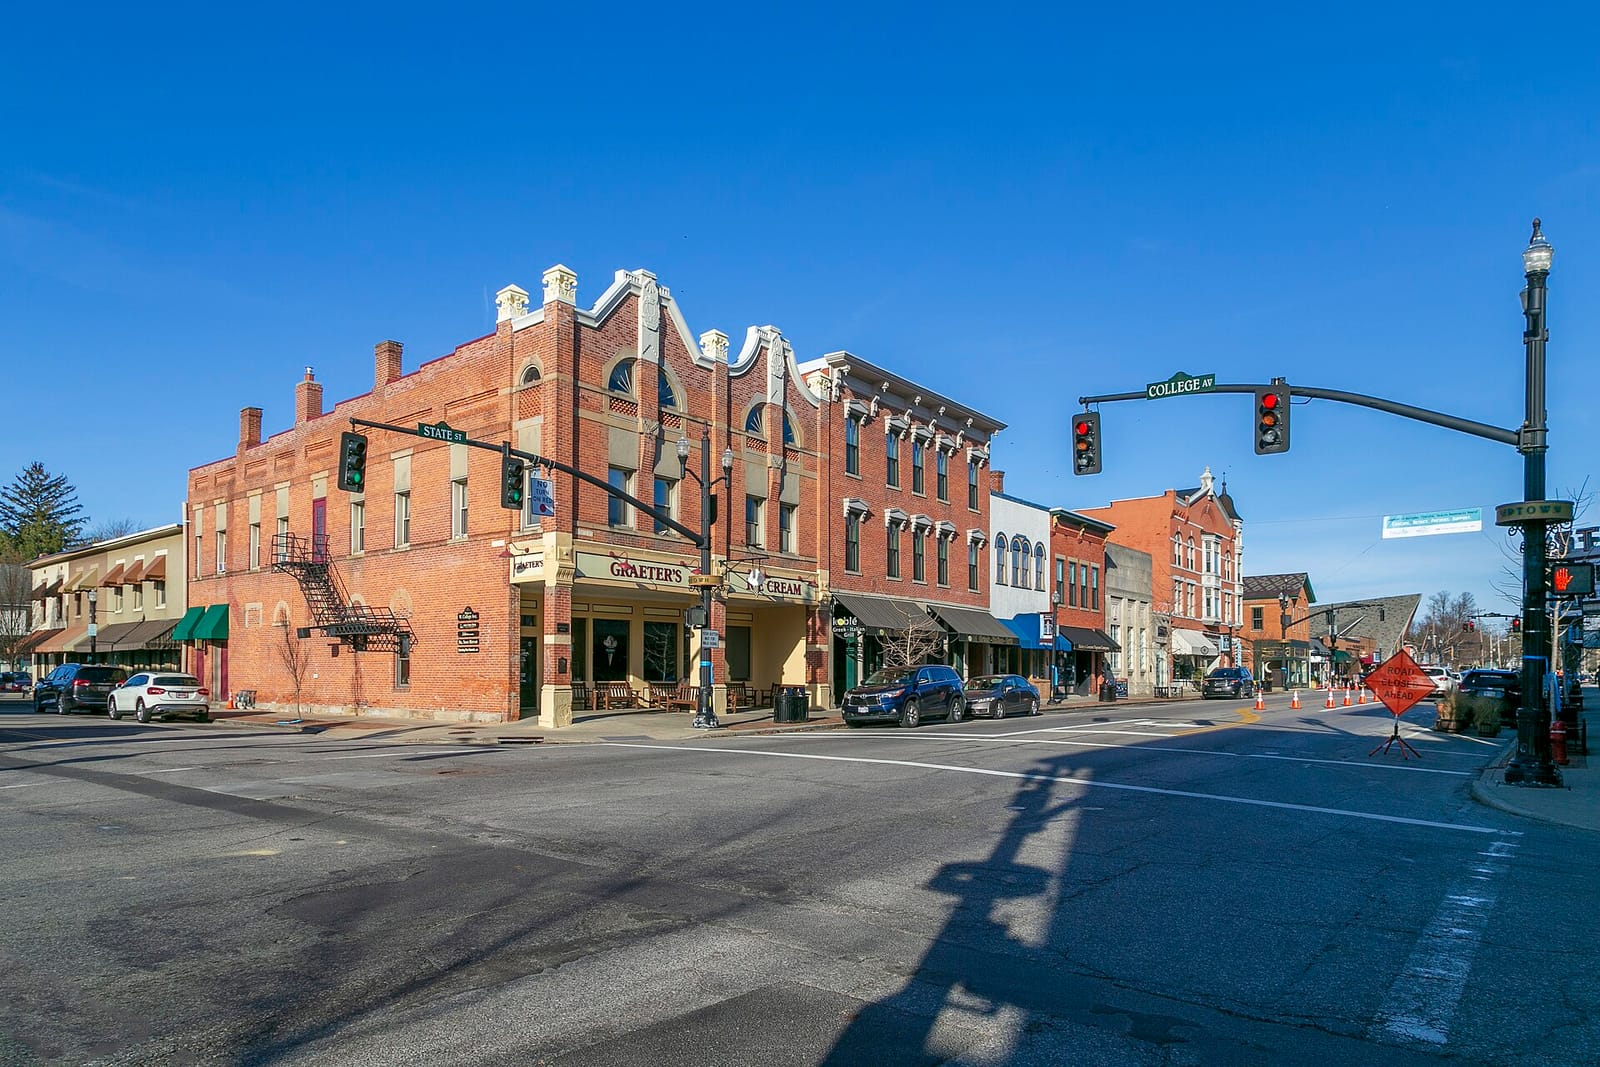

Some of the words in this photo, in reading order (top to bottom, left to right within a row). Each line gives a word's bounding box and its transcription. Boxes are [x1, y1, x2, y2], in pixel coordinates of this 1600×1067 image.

[1148, 378, 1201, 397] COLLEGE
[1201, 378, 1213, 388] AV
[423, 425, 453, 440] STATE
[454, 433, 463, 441] ST
[536, 480, 548, 489] NO
[610, 561, 682, 583] GRAETER'S
[766, 580, 801, 596] CREAM
[1387, 666, 1415, 676] ROAD
[1381, 678, 1418, 689] CLOSED
[1383, 690, 1414, 700] AHEAD
